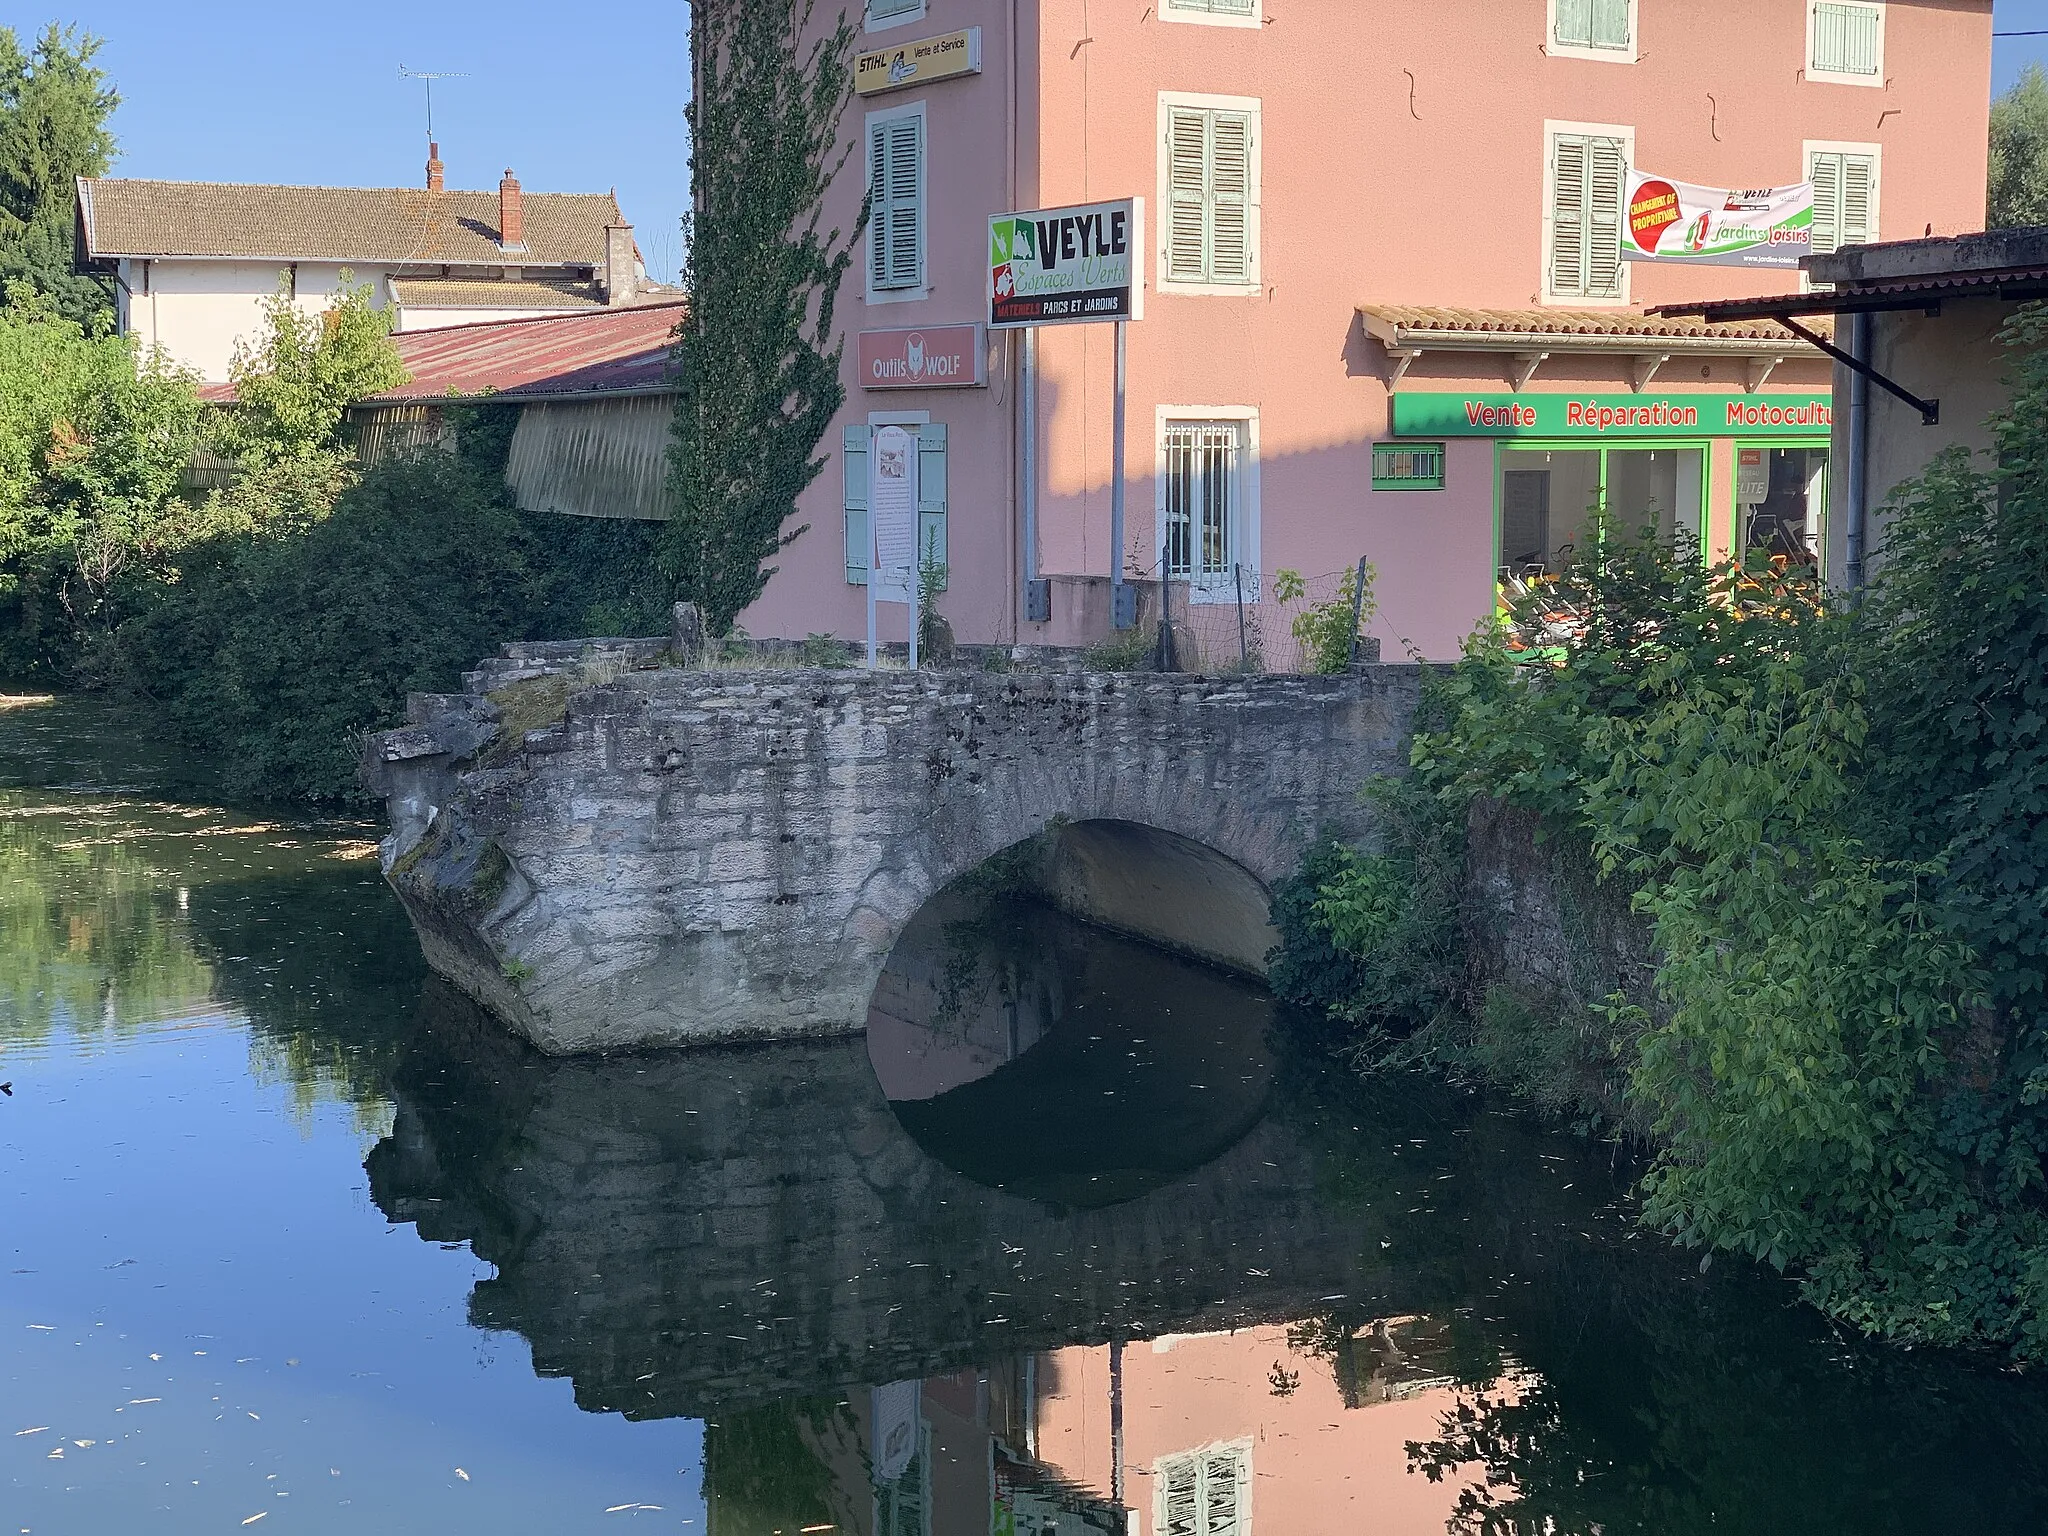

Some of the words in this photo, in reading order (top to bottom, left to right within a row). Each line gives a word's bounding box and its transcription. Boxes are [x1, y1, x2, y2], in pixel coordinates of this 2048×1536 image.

[859, 53, 887, 73] STIHL
[914, 46, 931, 59] Vente
[933, 43, 940, 55] et
[941, 37, 965, 52] Service
[1631, 194, 1667, 216] CHANGEMENT
[1632, 207, 1679, 232] PROPRIETAIRE
[1035, 210, 1127, 271] VEYLE
[1015, 261, 1075, 294] Espaces
[1080, 253, 1126, 287] Verts
[997, 302, 1041, 318] MATERIELS
[1043, 300, 1069, 315] PARCS
[1071, 299, 1082, 313] ET
[1084, 296, 1119, 312] JARDINS
[872, 358, 907, 379] Outils
[925, 354, 961, 376] WOLF
[1464, 400, 1537, 427] Vente
[1566, 400, 1698, 431] Réparation
[1741, 454, 1760, 462] STIHL
